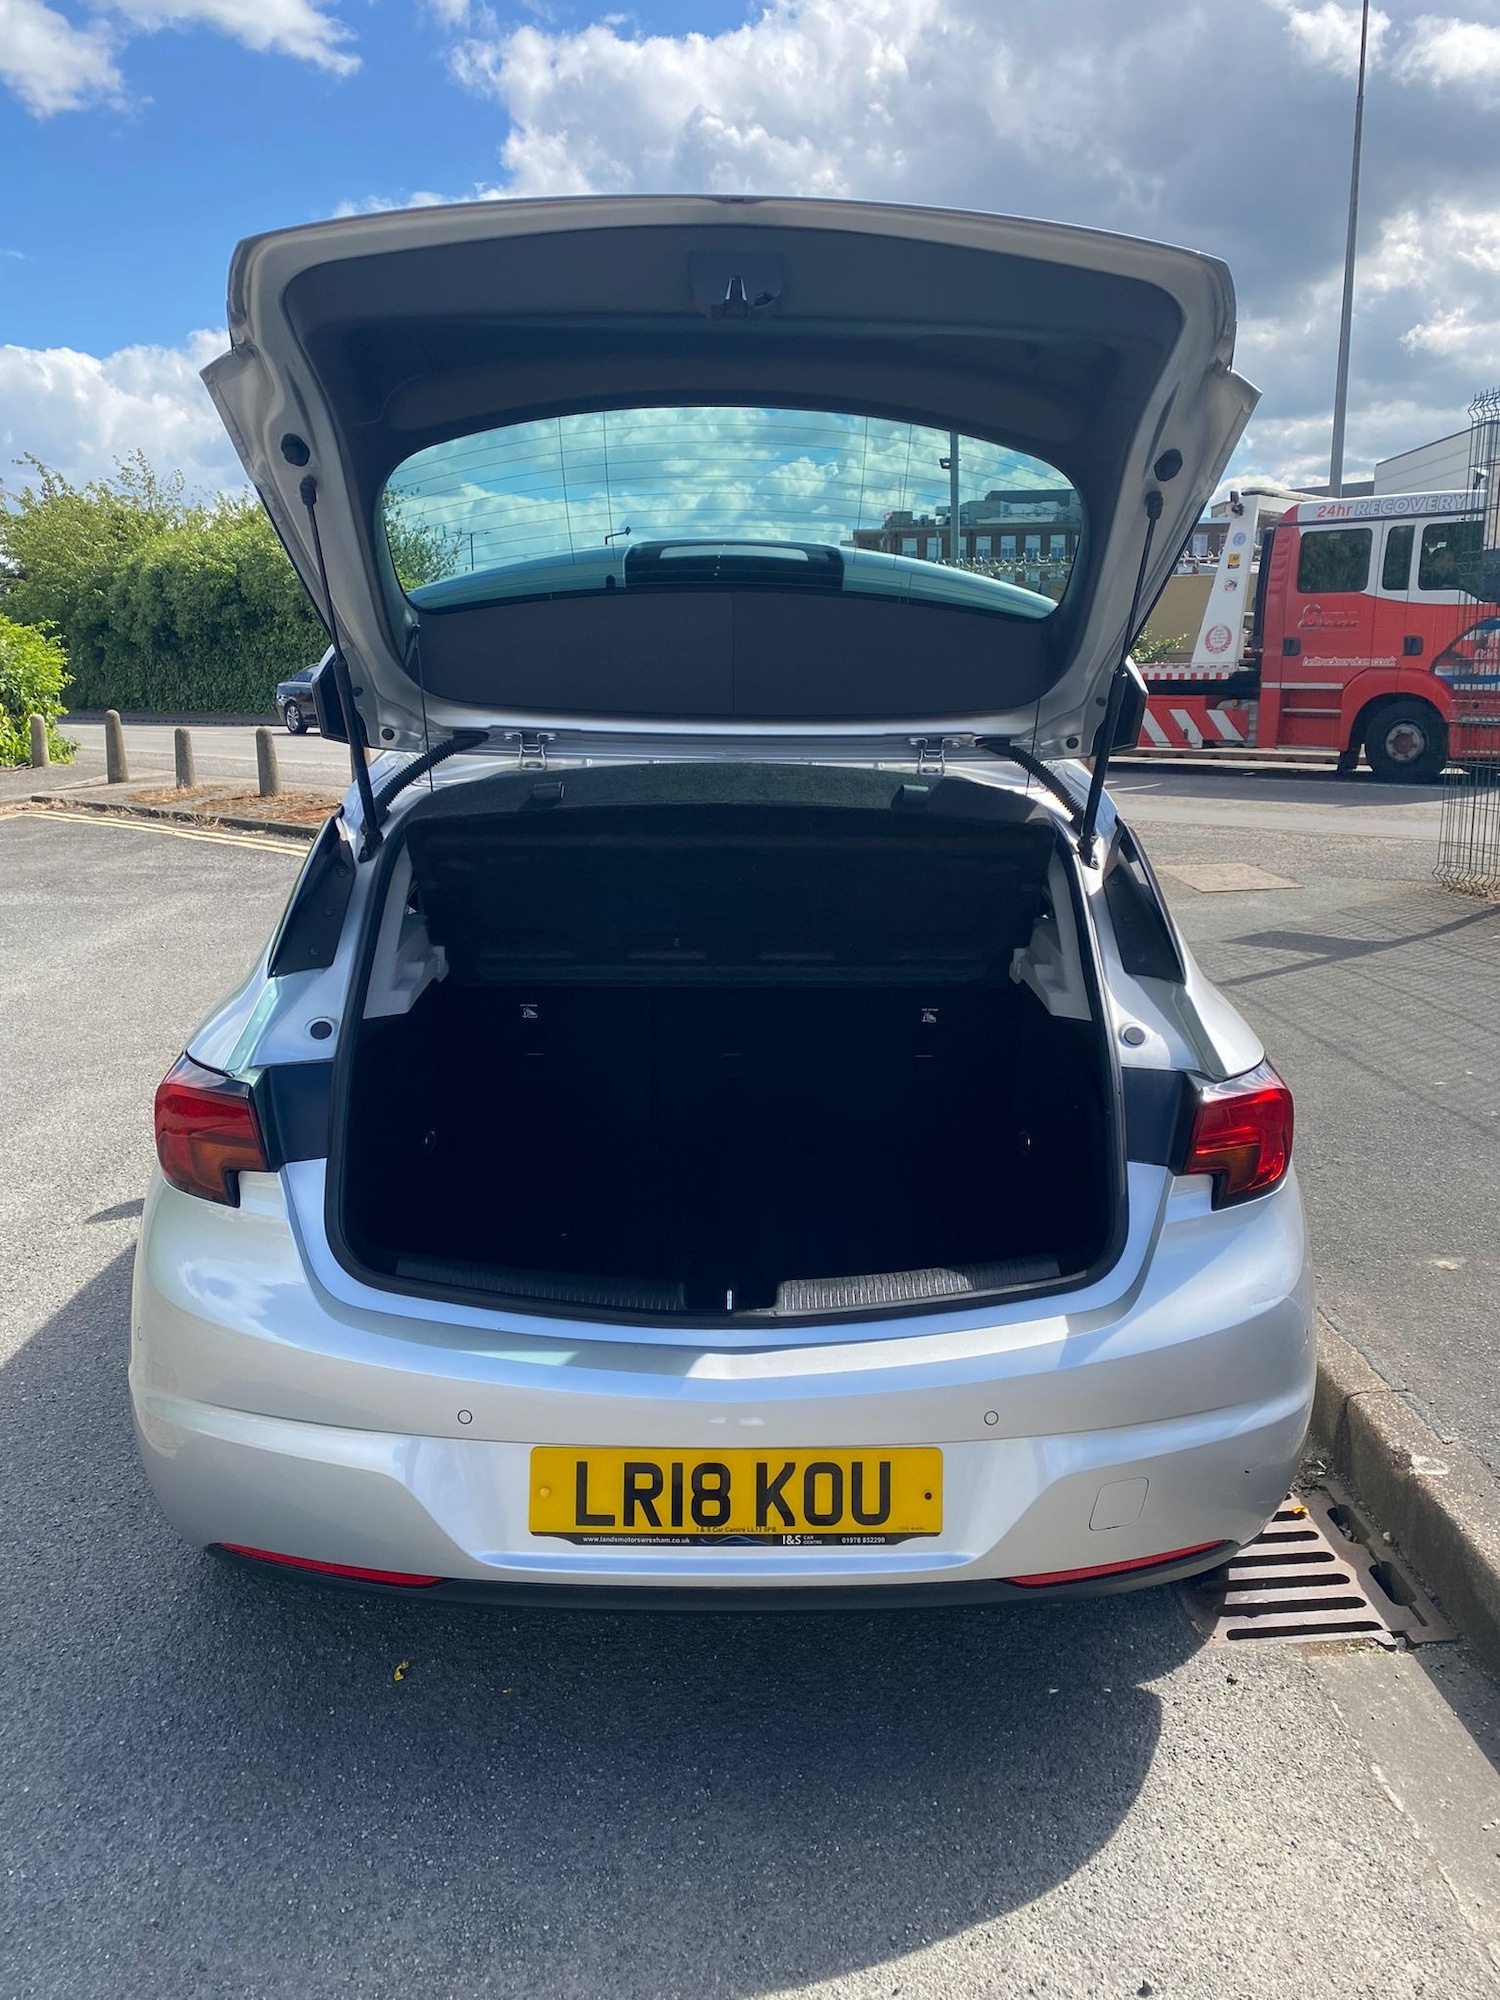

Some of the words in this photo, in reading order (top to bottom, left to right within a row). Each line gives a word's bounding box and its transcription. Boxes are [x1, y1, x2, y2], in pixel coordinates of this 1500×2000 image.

[1316, 503, 1354, 518] 24hr
[1354, 493, 1469, 517] RECOVERY
[575, 1461, 731, 1527] LR18
[756, 1461, 891, 1527] KOU
[841, 1536, 861, 1544] 01978
